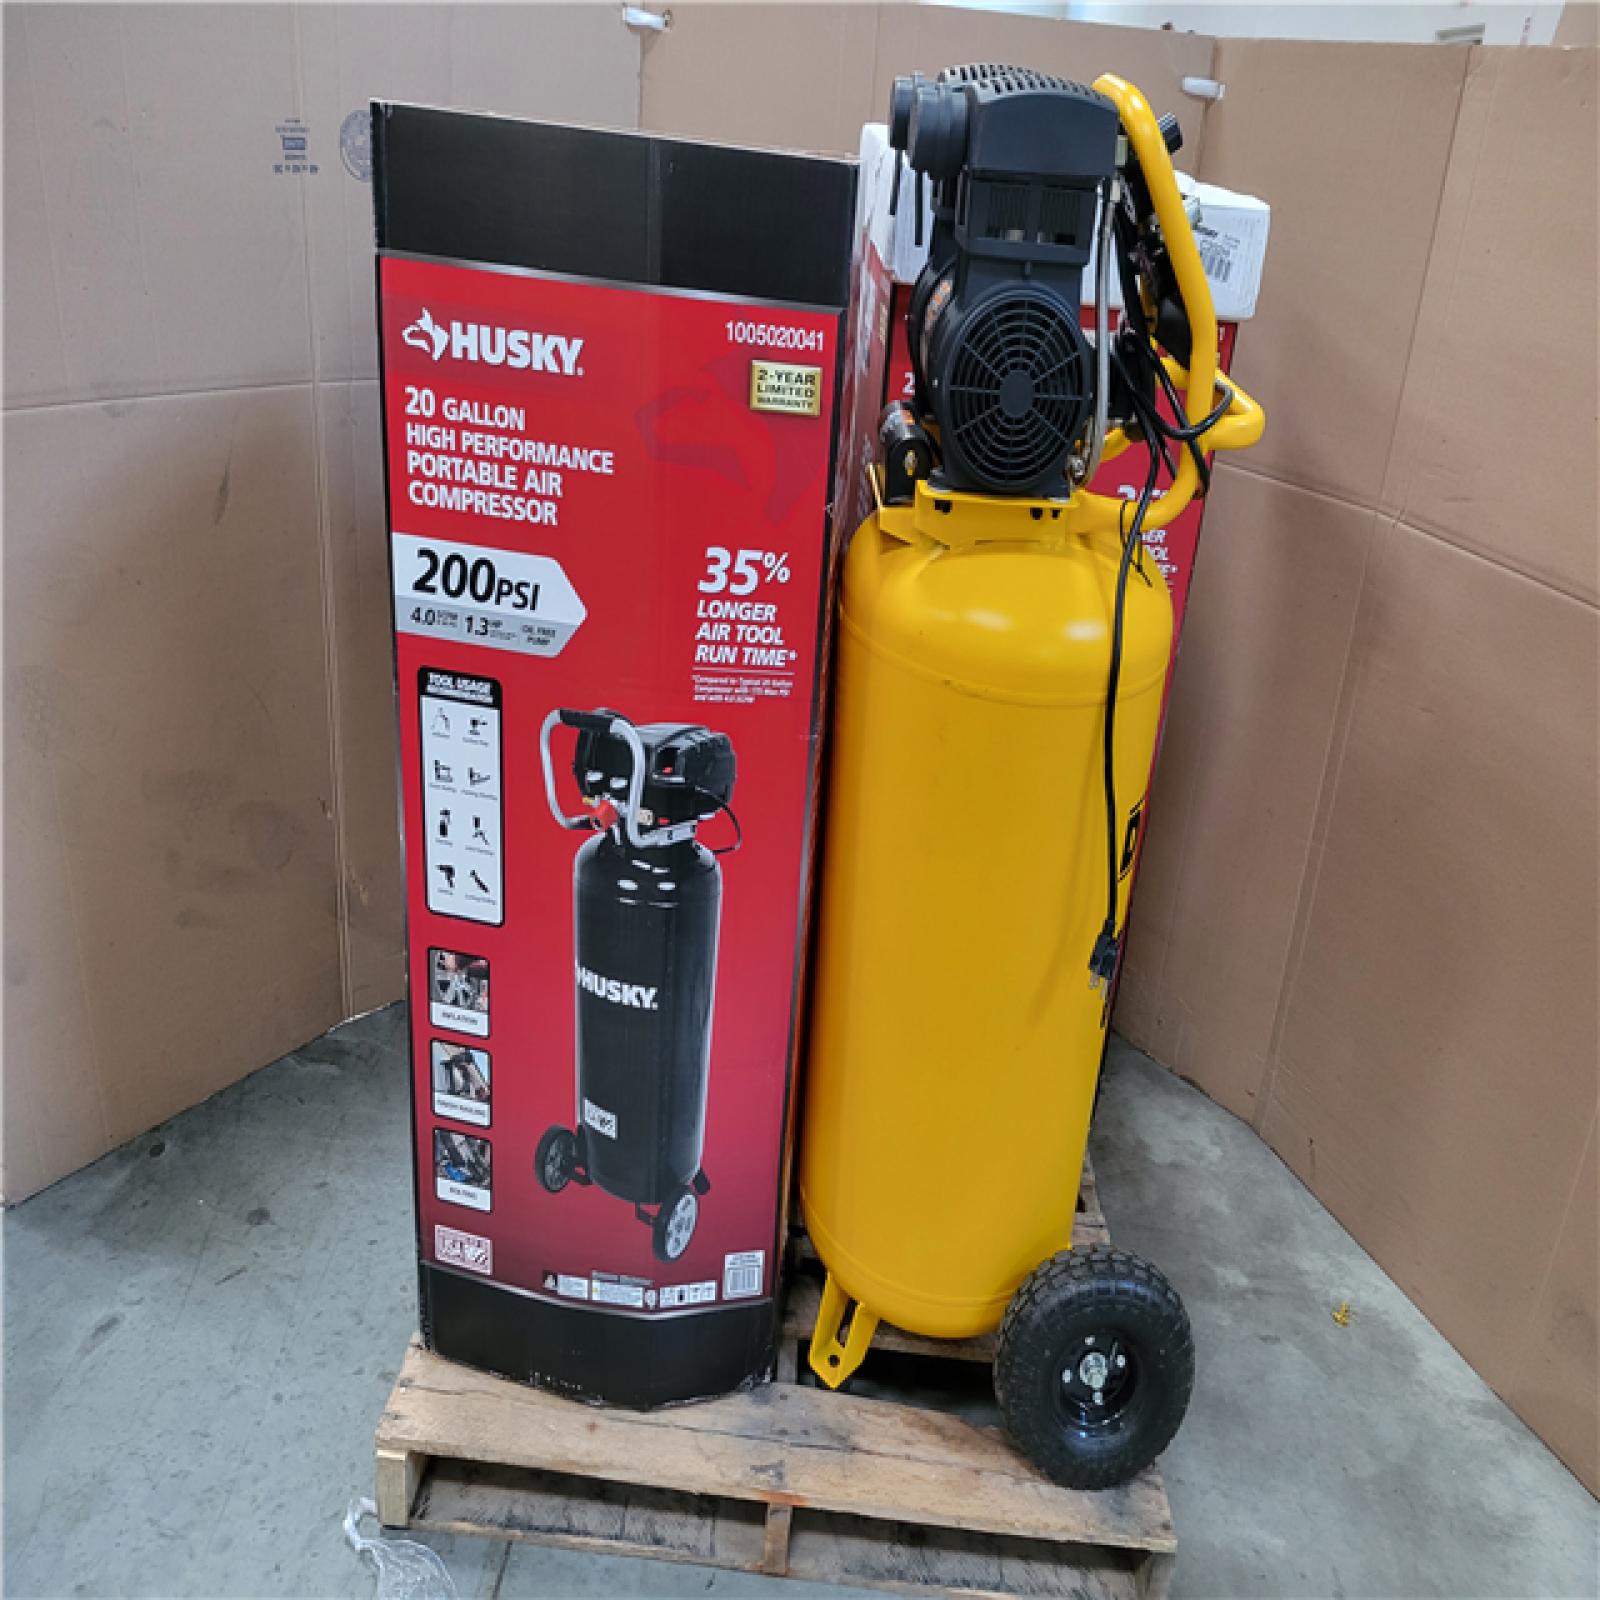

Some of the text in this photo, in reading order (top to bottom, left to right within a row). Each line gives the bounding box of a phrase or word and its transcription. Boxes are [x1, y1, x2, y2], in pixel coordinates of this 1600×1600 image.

[725, 320, 823, 352] 1005020041
[757, 369, 816, 385] 2-YEAR
[757, 382, 815, 398] LIMITED
[405, 385, 526, 431] 20 GALLON
[406, 422, 614, 474] HIGH PERFORMANCE
[407, 450, 563, 497] PORTABLE AIR
[408, 480, 558, 526] COMPRESSOR
[697, 547, 791, 596] 35%
[410, 607, 436, 626] 4.0
[697, 600, 777, 623] LONGER
[466, 615, 489, 636] 1.3
[695, 622, 785, 646] AIR TOOL
[695, 644, 738, 664] RUN
